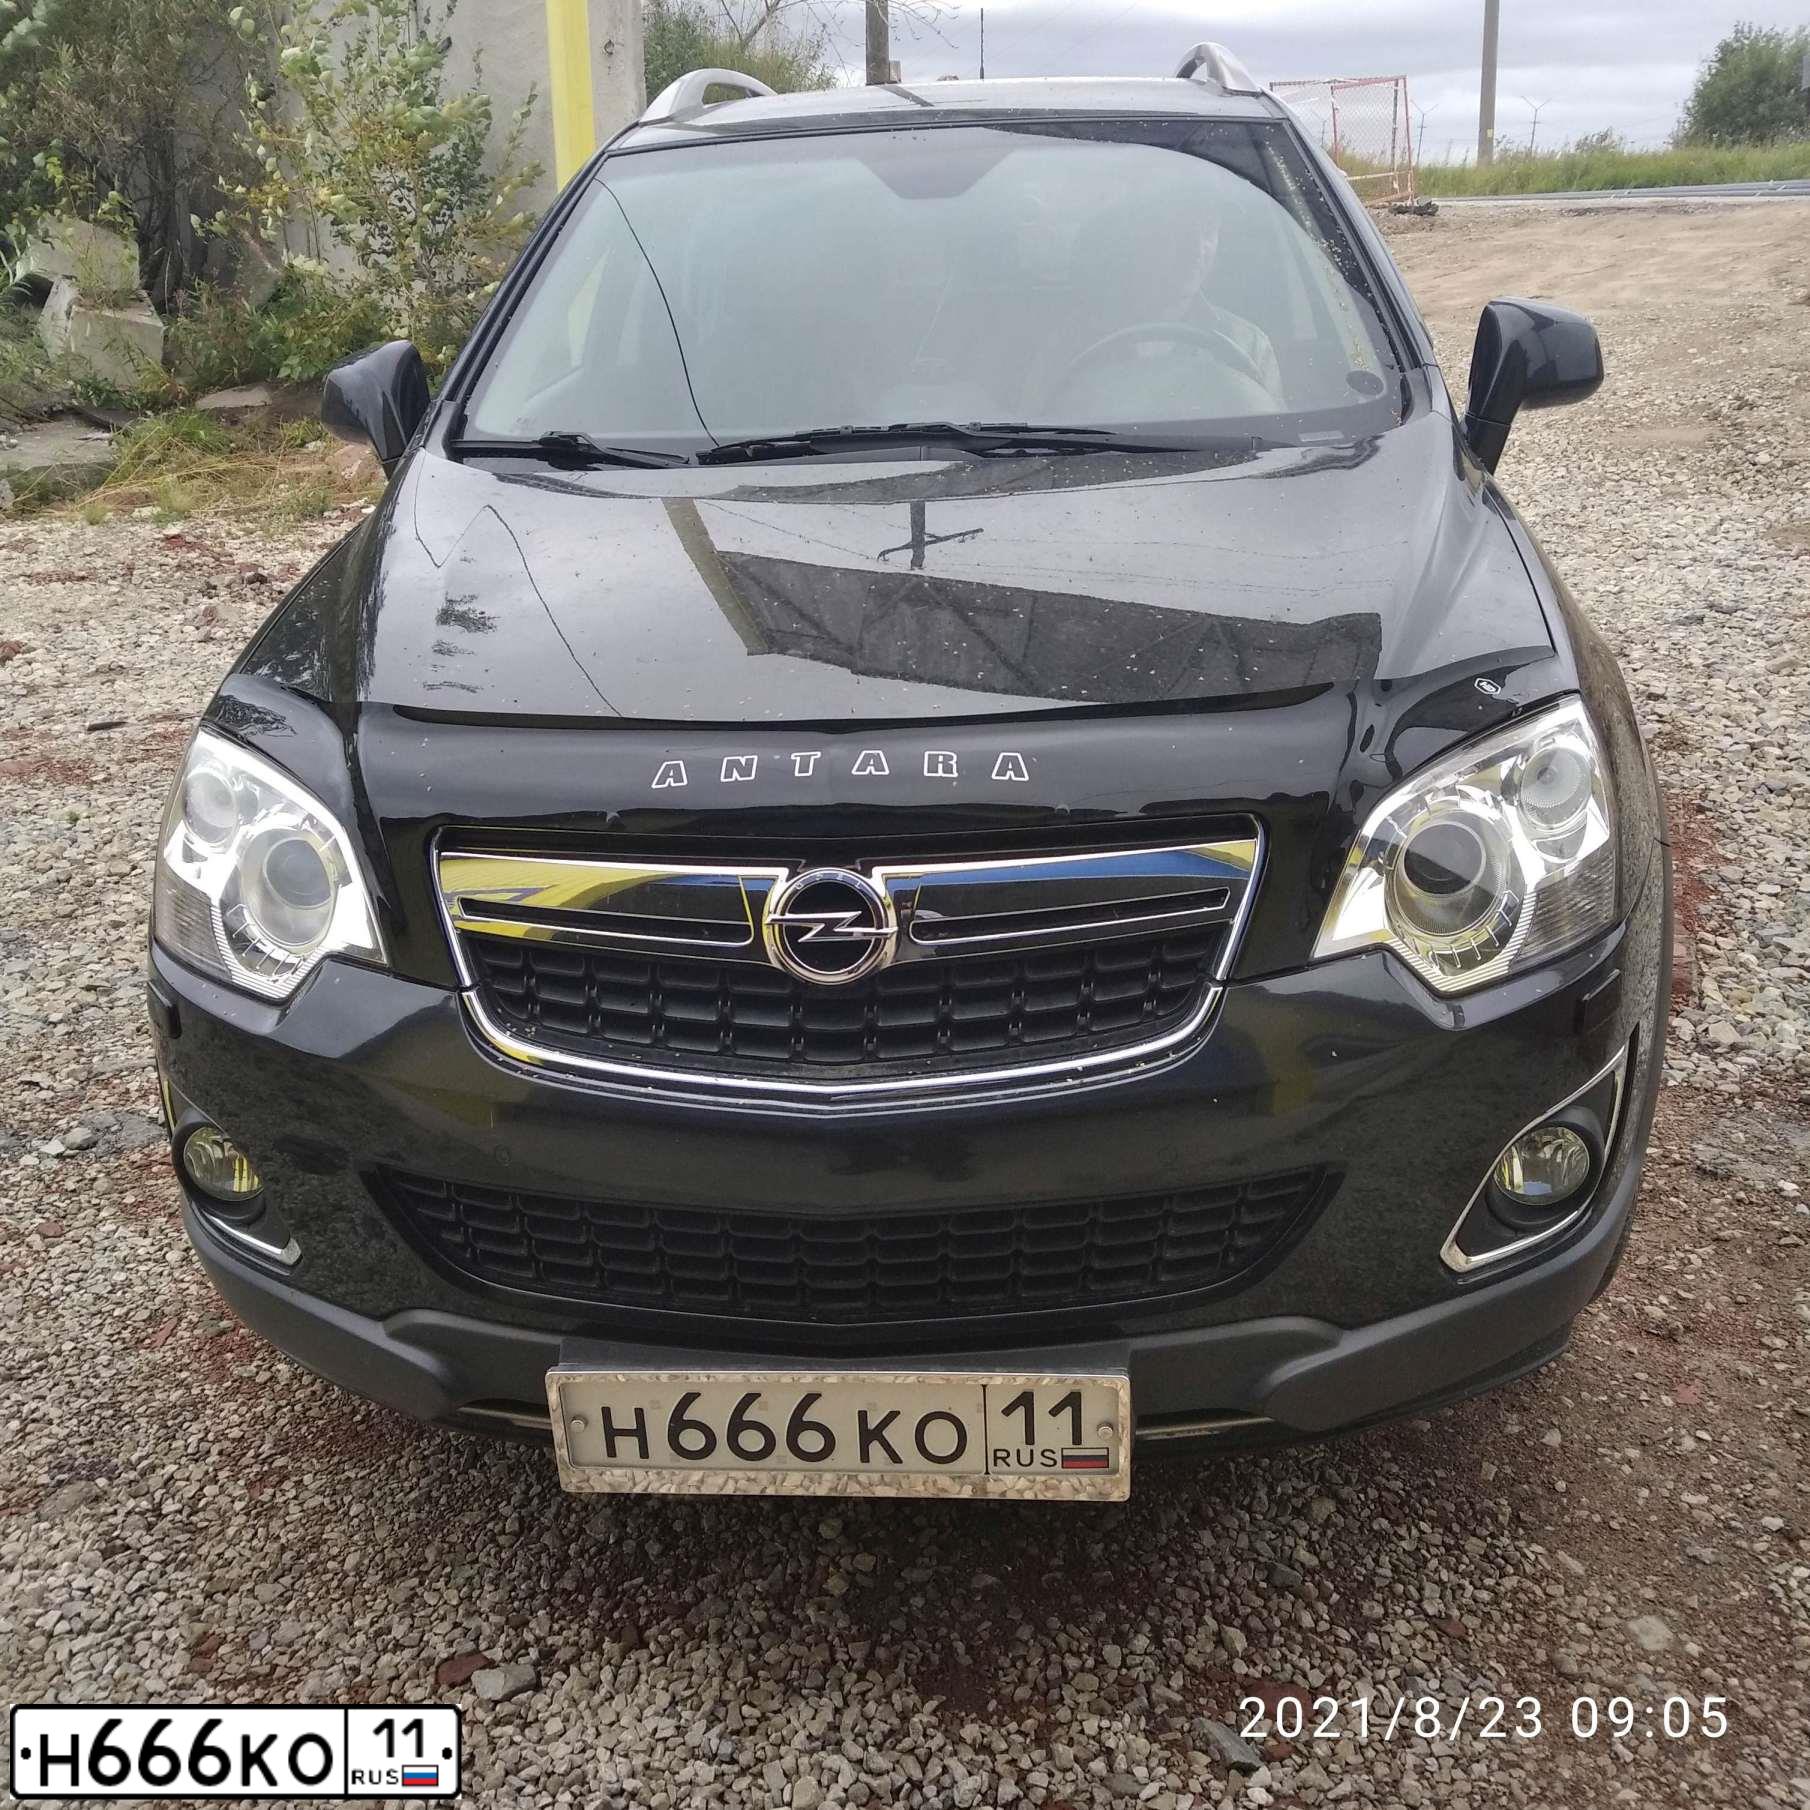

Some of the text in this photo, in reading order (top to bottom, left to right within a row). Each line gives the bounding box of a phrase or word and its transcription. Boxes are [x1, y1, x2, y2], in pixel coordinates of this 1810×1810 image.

[651, 750, 1029, 788] ANTARA
[1001, 1390, 1083, 1446] 11
[993, 1448, 1058, 1468] RUS
